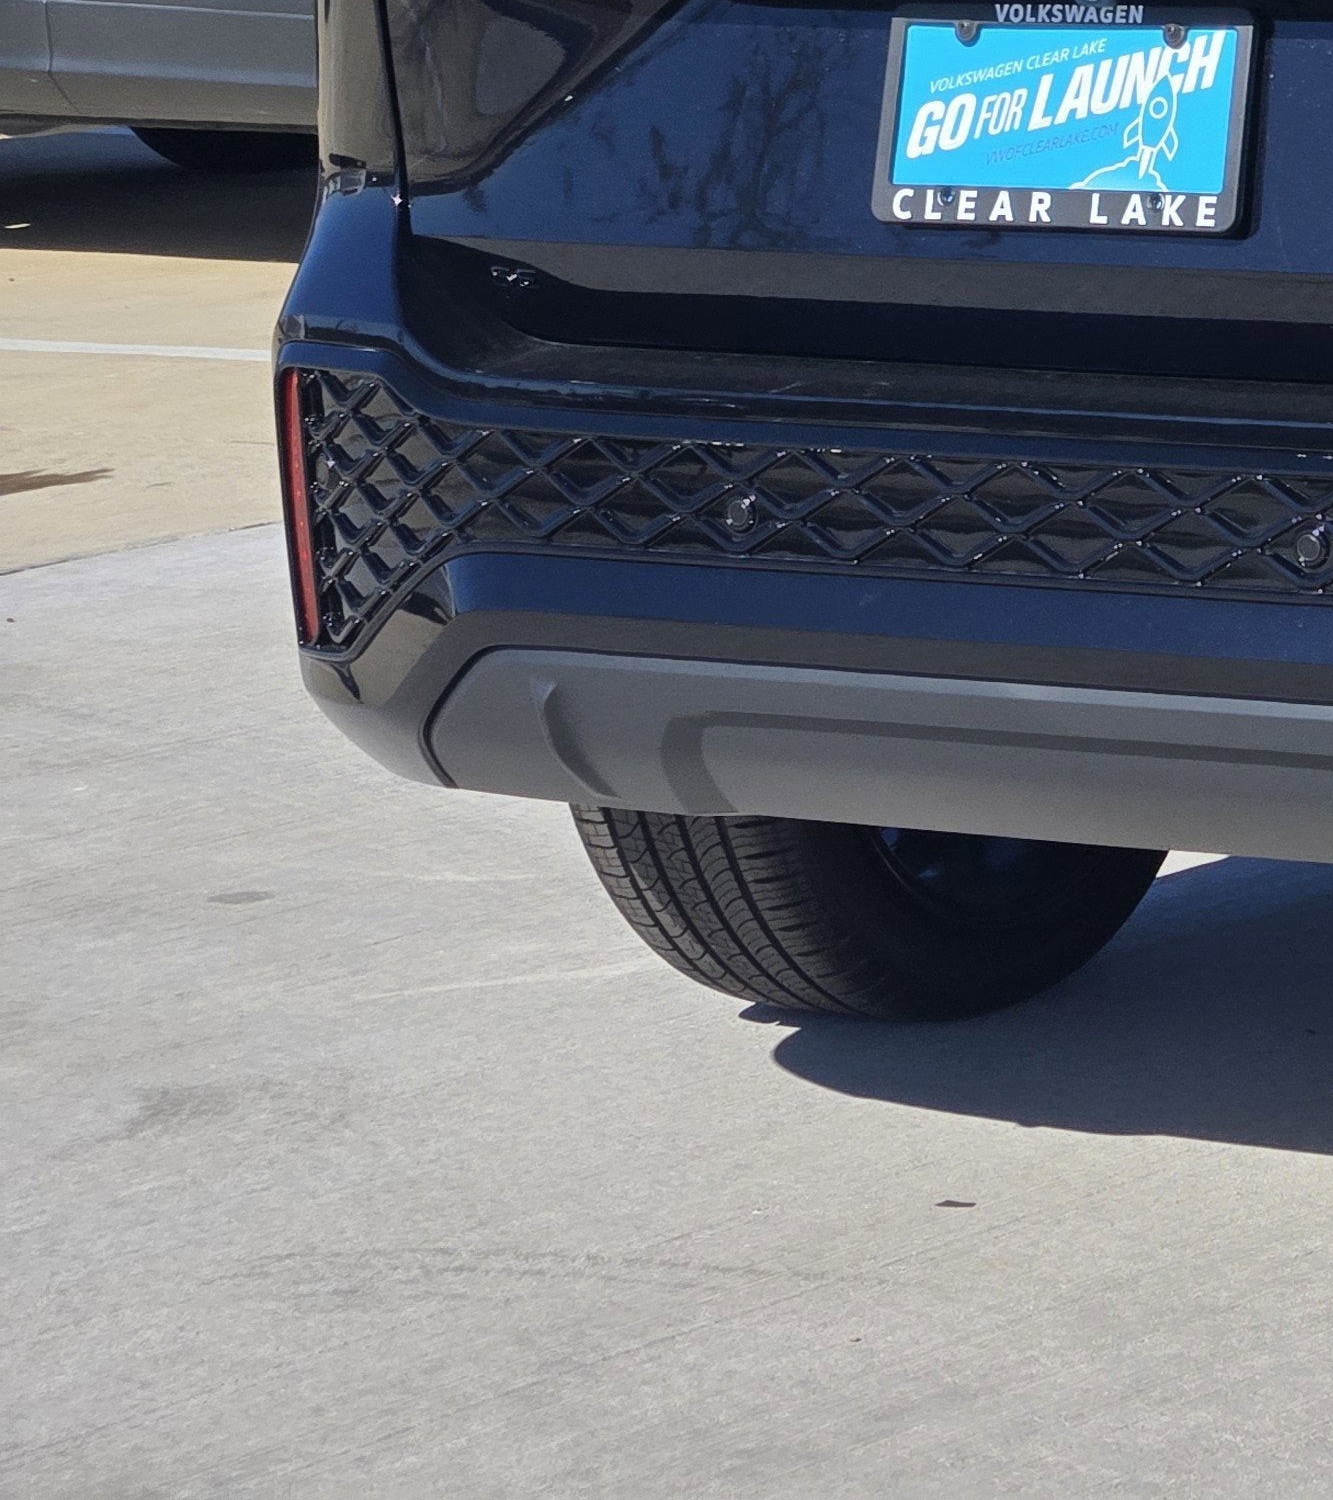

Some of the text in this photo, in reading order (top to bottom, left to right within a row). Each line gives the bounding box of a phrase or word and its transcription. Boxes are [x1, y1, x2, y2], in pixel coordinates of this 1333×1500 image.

[994, 3, 1144, 24] VOLKSWAGEN
[929, 37, 1109, 94] VOLKSWAGEN CLEAR LAKE
[906, 30, 1227, 159] GO FOR LAUNCH
[984, 122, 1120, 166] VWOFCLEARLAKE.COM
[891, 188, 1218, 227] CLEAR LAKE
